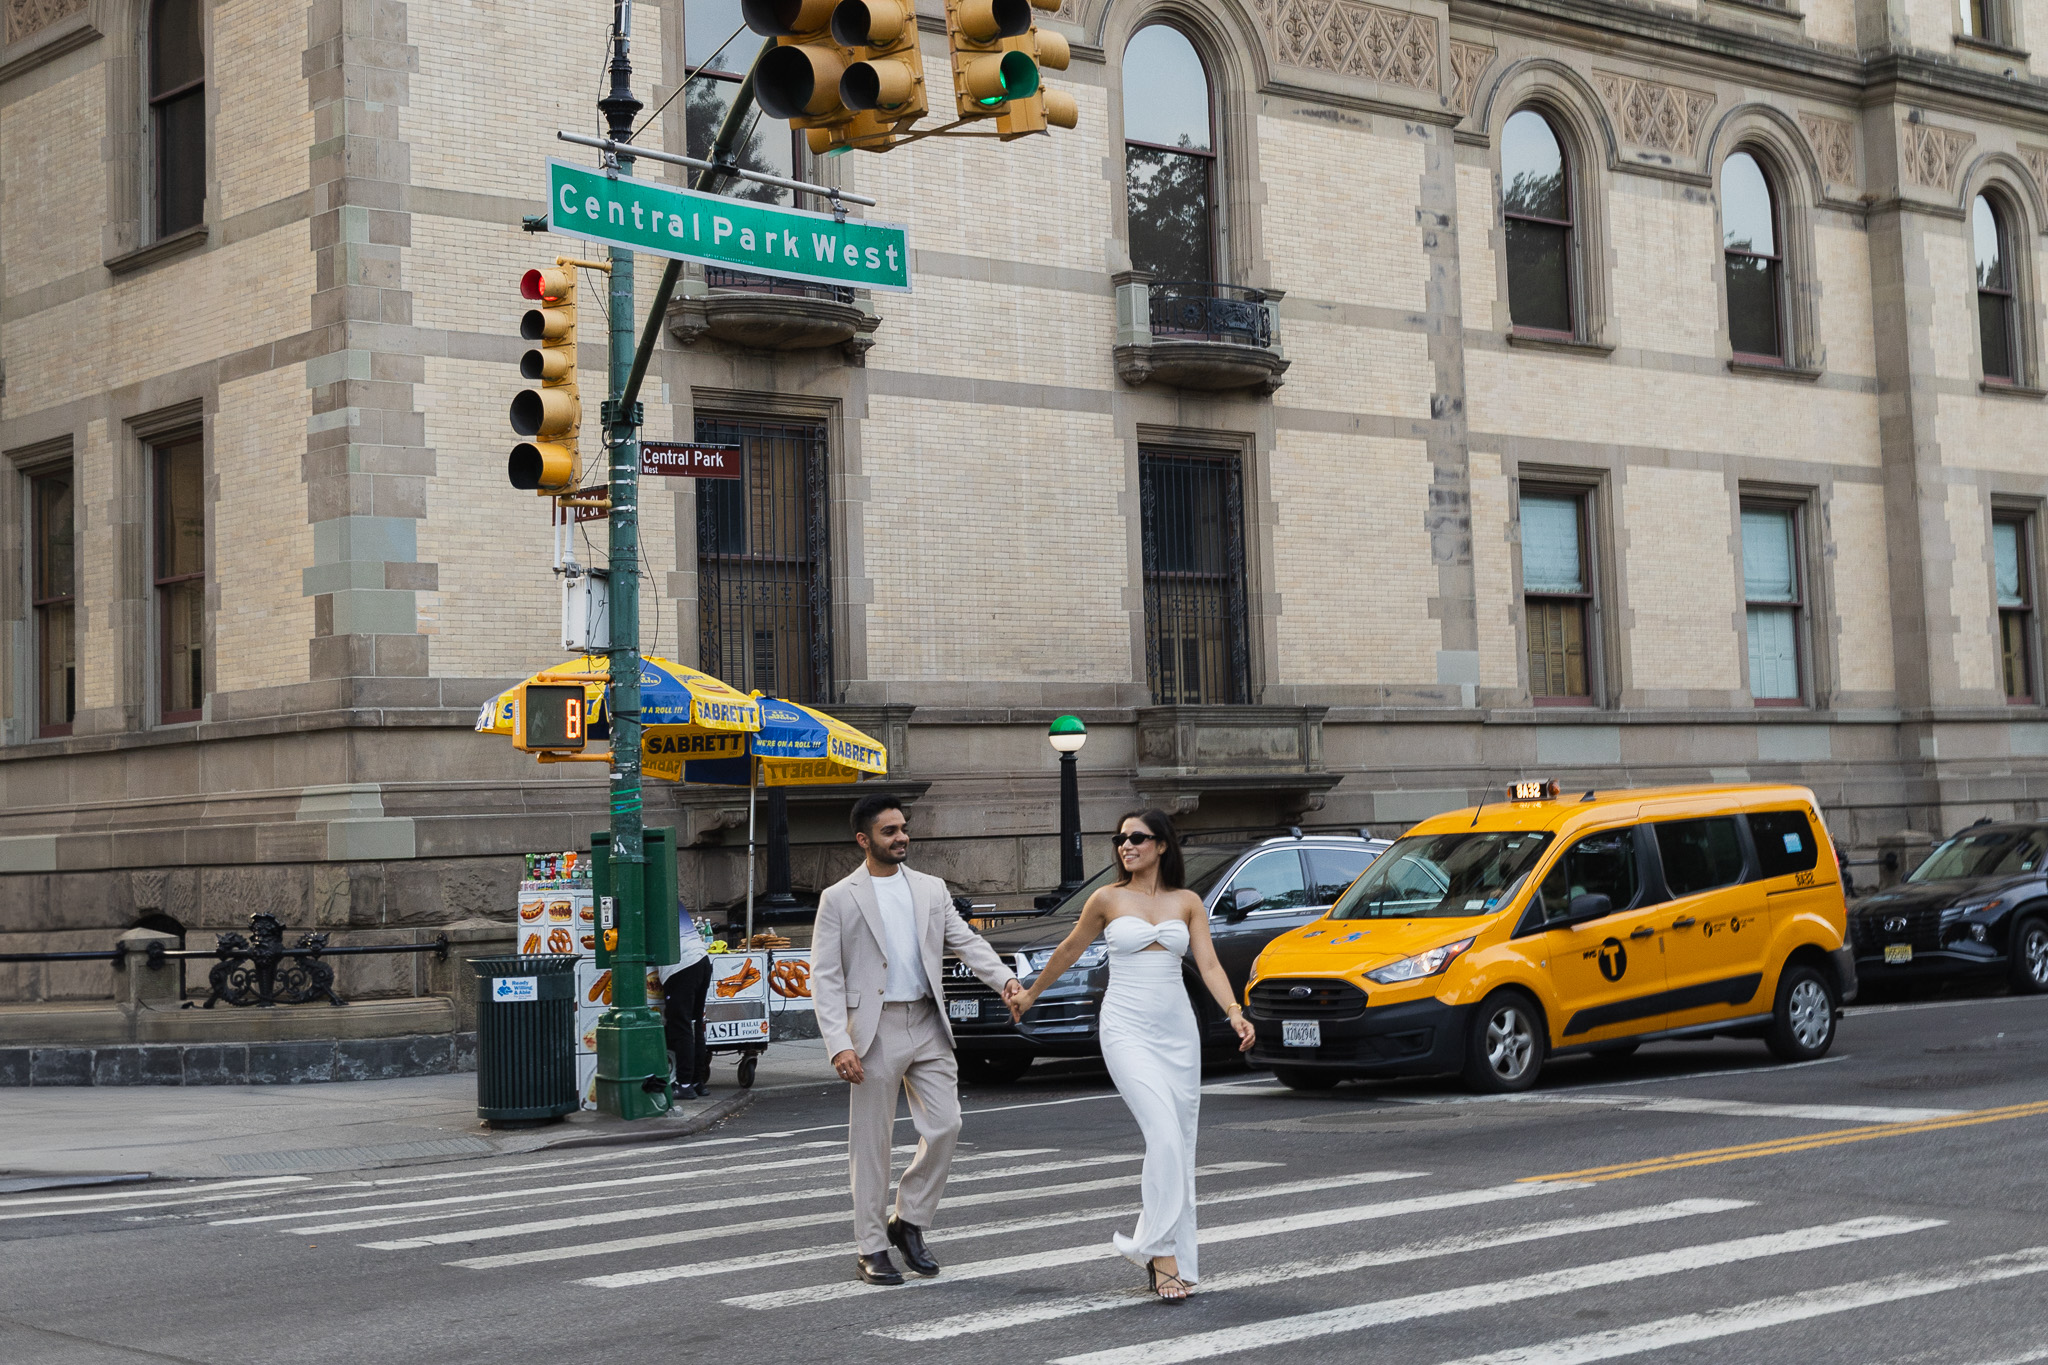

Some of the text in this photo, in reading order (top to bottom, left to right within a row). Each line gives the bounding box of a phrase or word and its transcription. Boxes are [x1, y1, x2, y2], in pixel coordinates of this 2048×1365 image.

[559, 183, 899, 272] Central Park West
[643, 447, 724, 468] Central Park
[643, 465, 659, 474] West
[697, 701, 756, 723] SABRETT
[647, 733, 743, 754] SABRETT
[756, 739, 776, 747] WE'RE
[832, 738, 882, 766] SABRETT
[1516, 782, 1541, 799] 8A32
[1602, 944, 1620, 977] T
[708, 1022, 740, 1039] ASH
